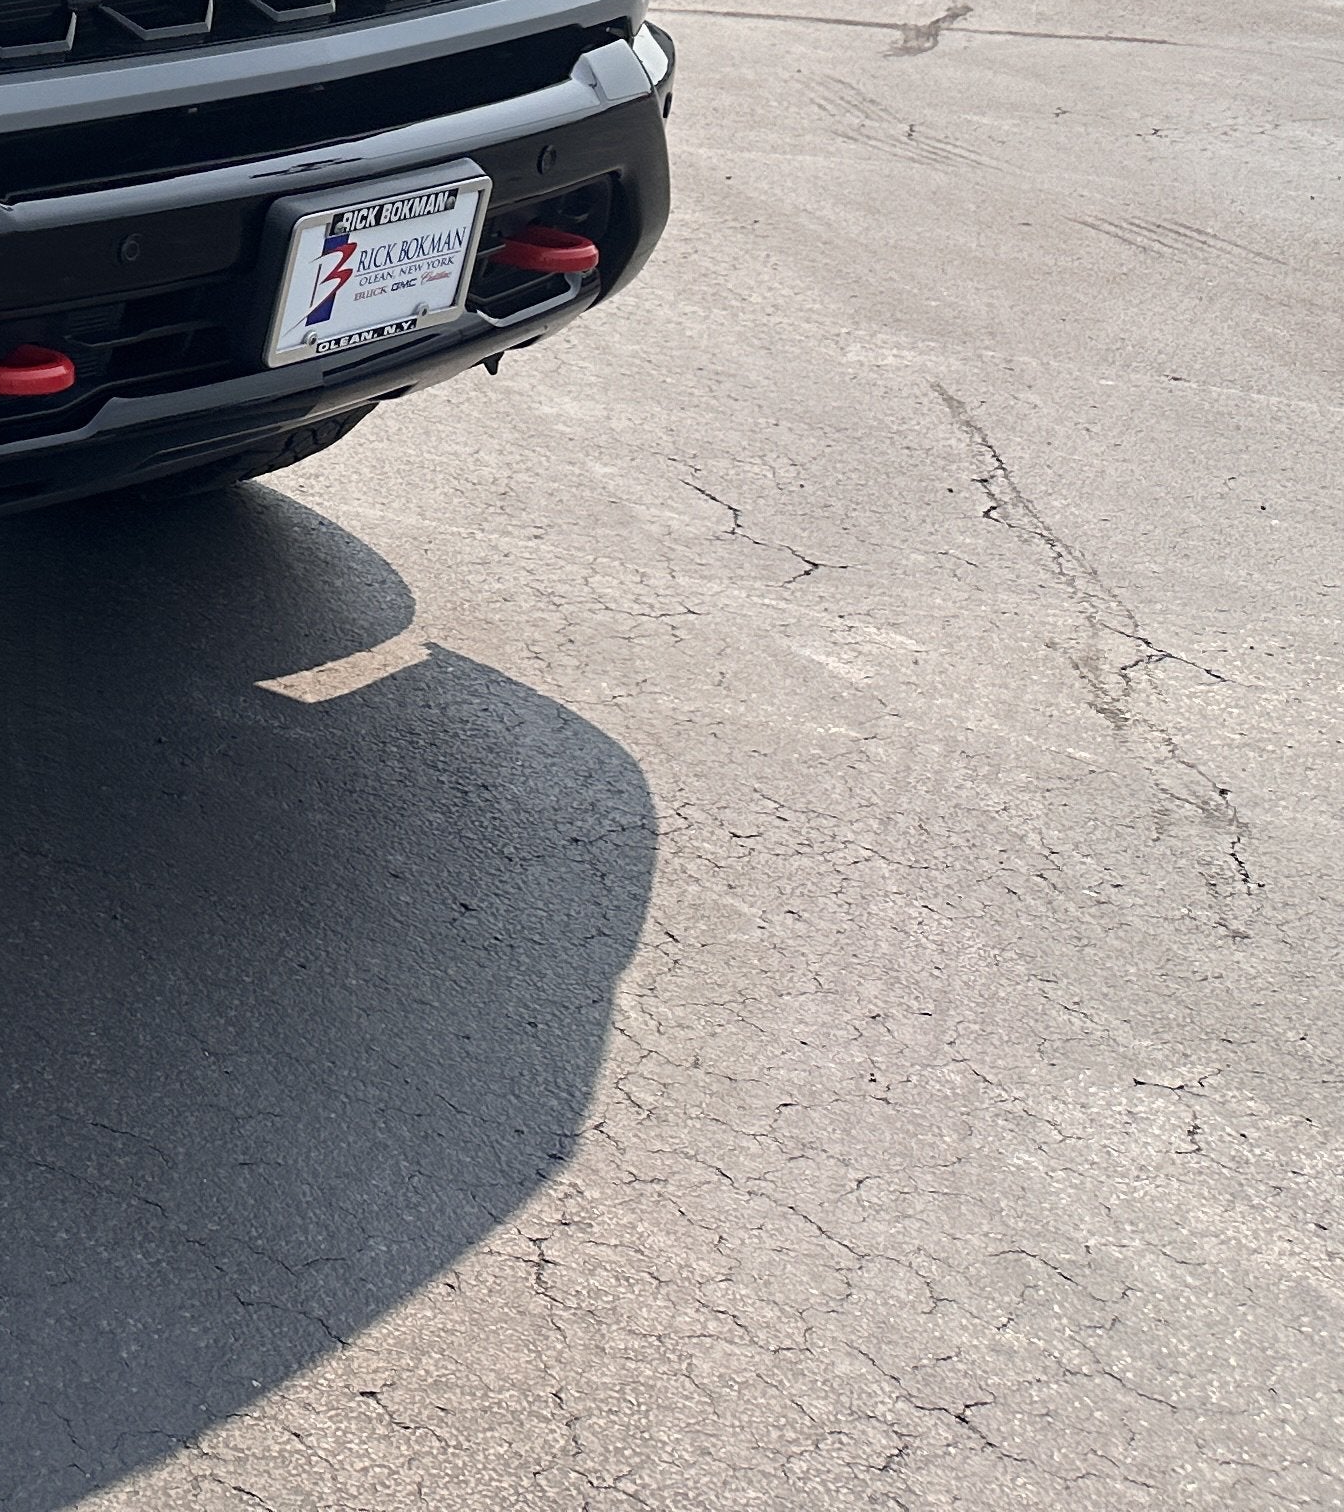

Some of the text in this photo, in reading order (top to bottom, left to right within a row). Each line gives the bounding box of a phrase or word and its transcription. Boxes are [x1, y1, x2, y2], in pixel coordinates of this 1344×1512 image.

[342, 191, 450, 232] RICK BOKMAN
[356, 226, 467, 273] RICK BOKMAN
[399, 262, 424, 277] NEW
[425, 255, 455, 270] YORK
[390, 278, 417, 291] GMC
